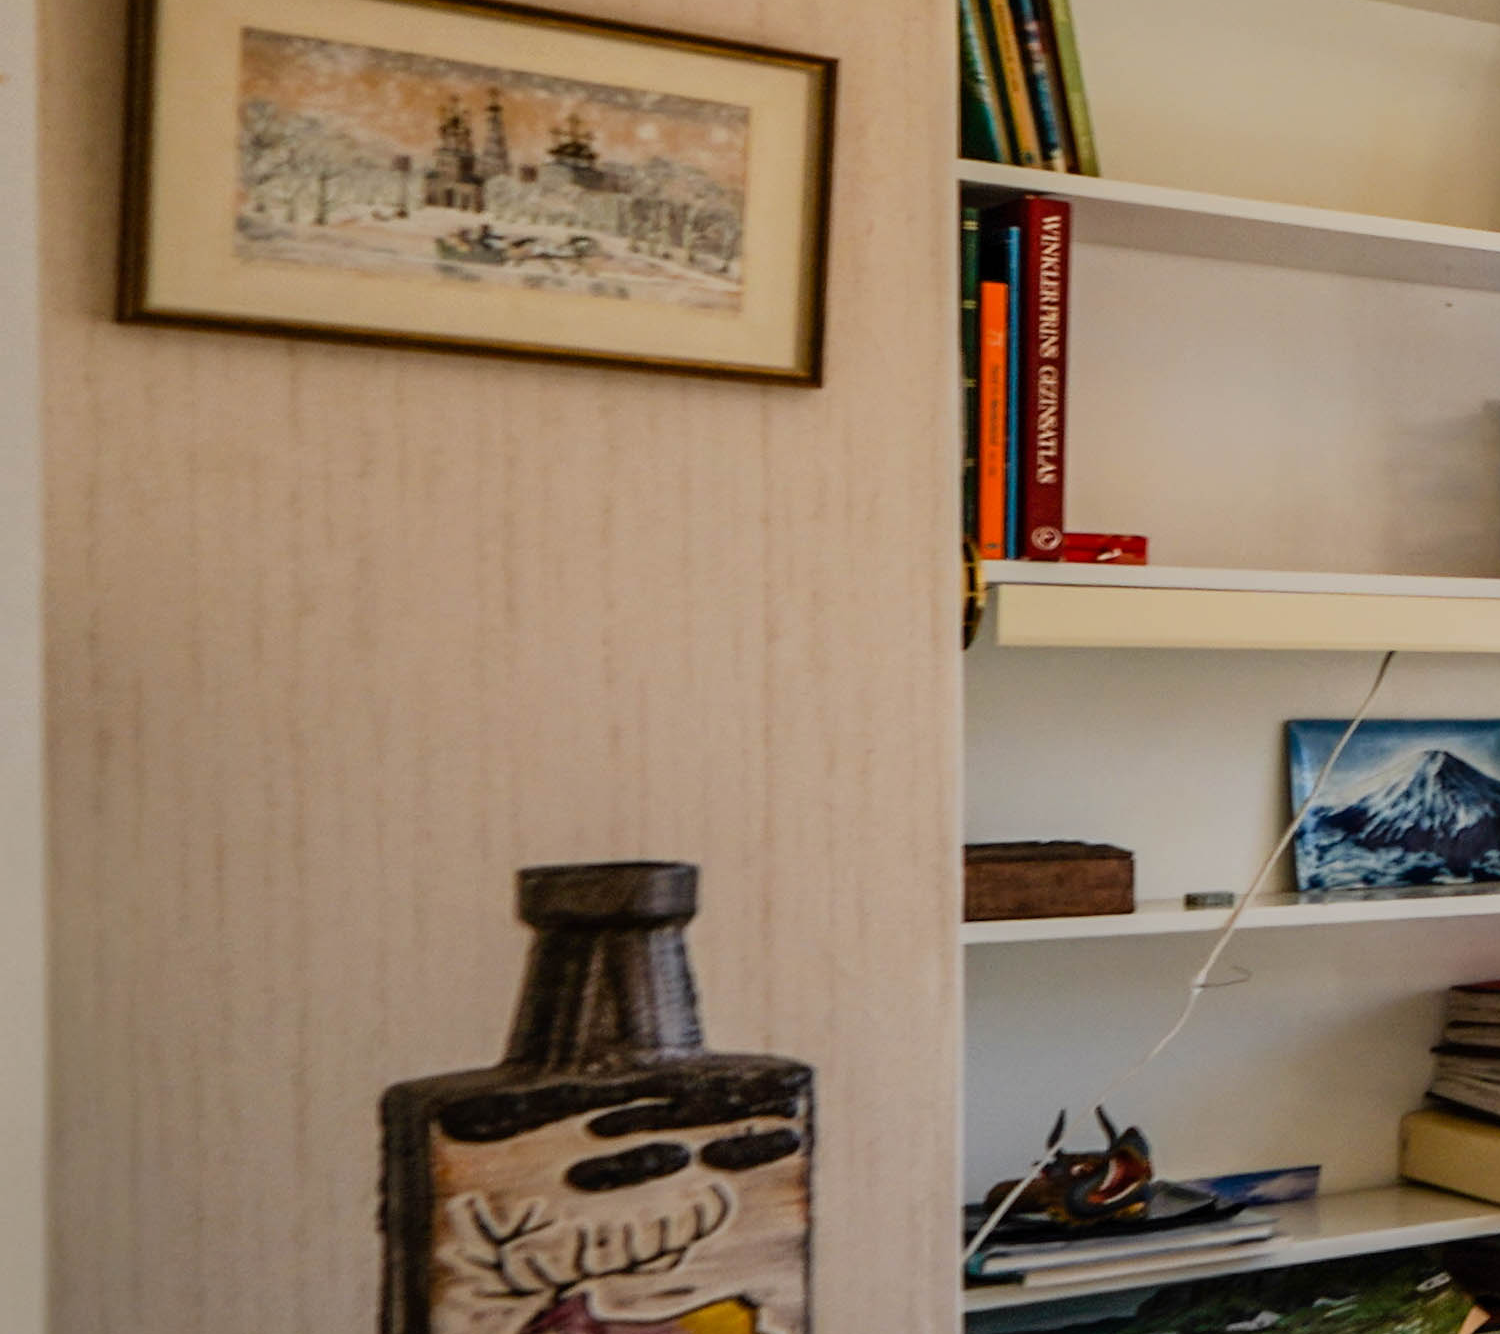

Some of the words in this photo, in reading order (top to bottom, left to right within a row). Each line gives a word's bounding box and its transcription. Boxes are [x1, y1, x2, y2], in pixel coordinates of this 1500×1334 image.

[1040, 214, 1062, 303] WINKLER
[1039, 304, 1060, 359] PRINS
[1036, 364, 1060, 484] GEZINSATLAS
